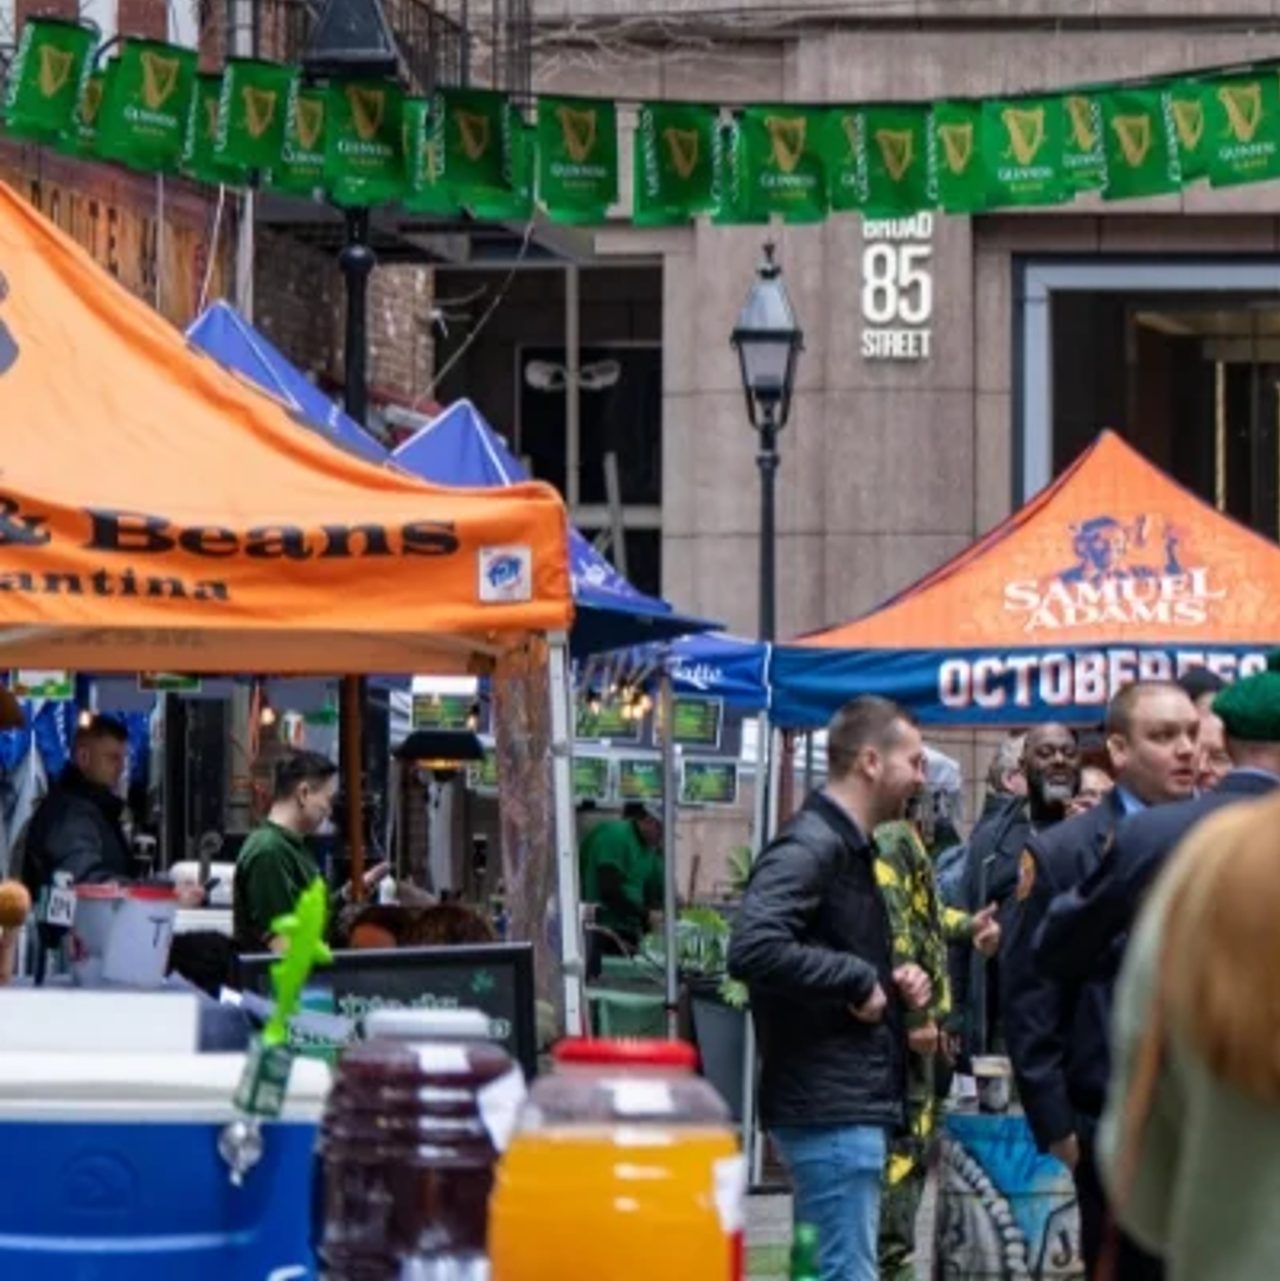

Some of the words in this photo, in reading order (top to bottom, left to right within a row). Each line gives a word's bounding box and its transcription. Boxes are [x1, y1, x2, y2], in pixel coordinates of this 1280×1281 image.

[863, 243, 932, 325] 85
[861, 329, 931, 358] STREET
[82, 507, 460, 560] Beans
[1004, 567, 1226, 614] SAMUEL
[1023, 600, 1208, 633] ADAMS
